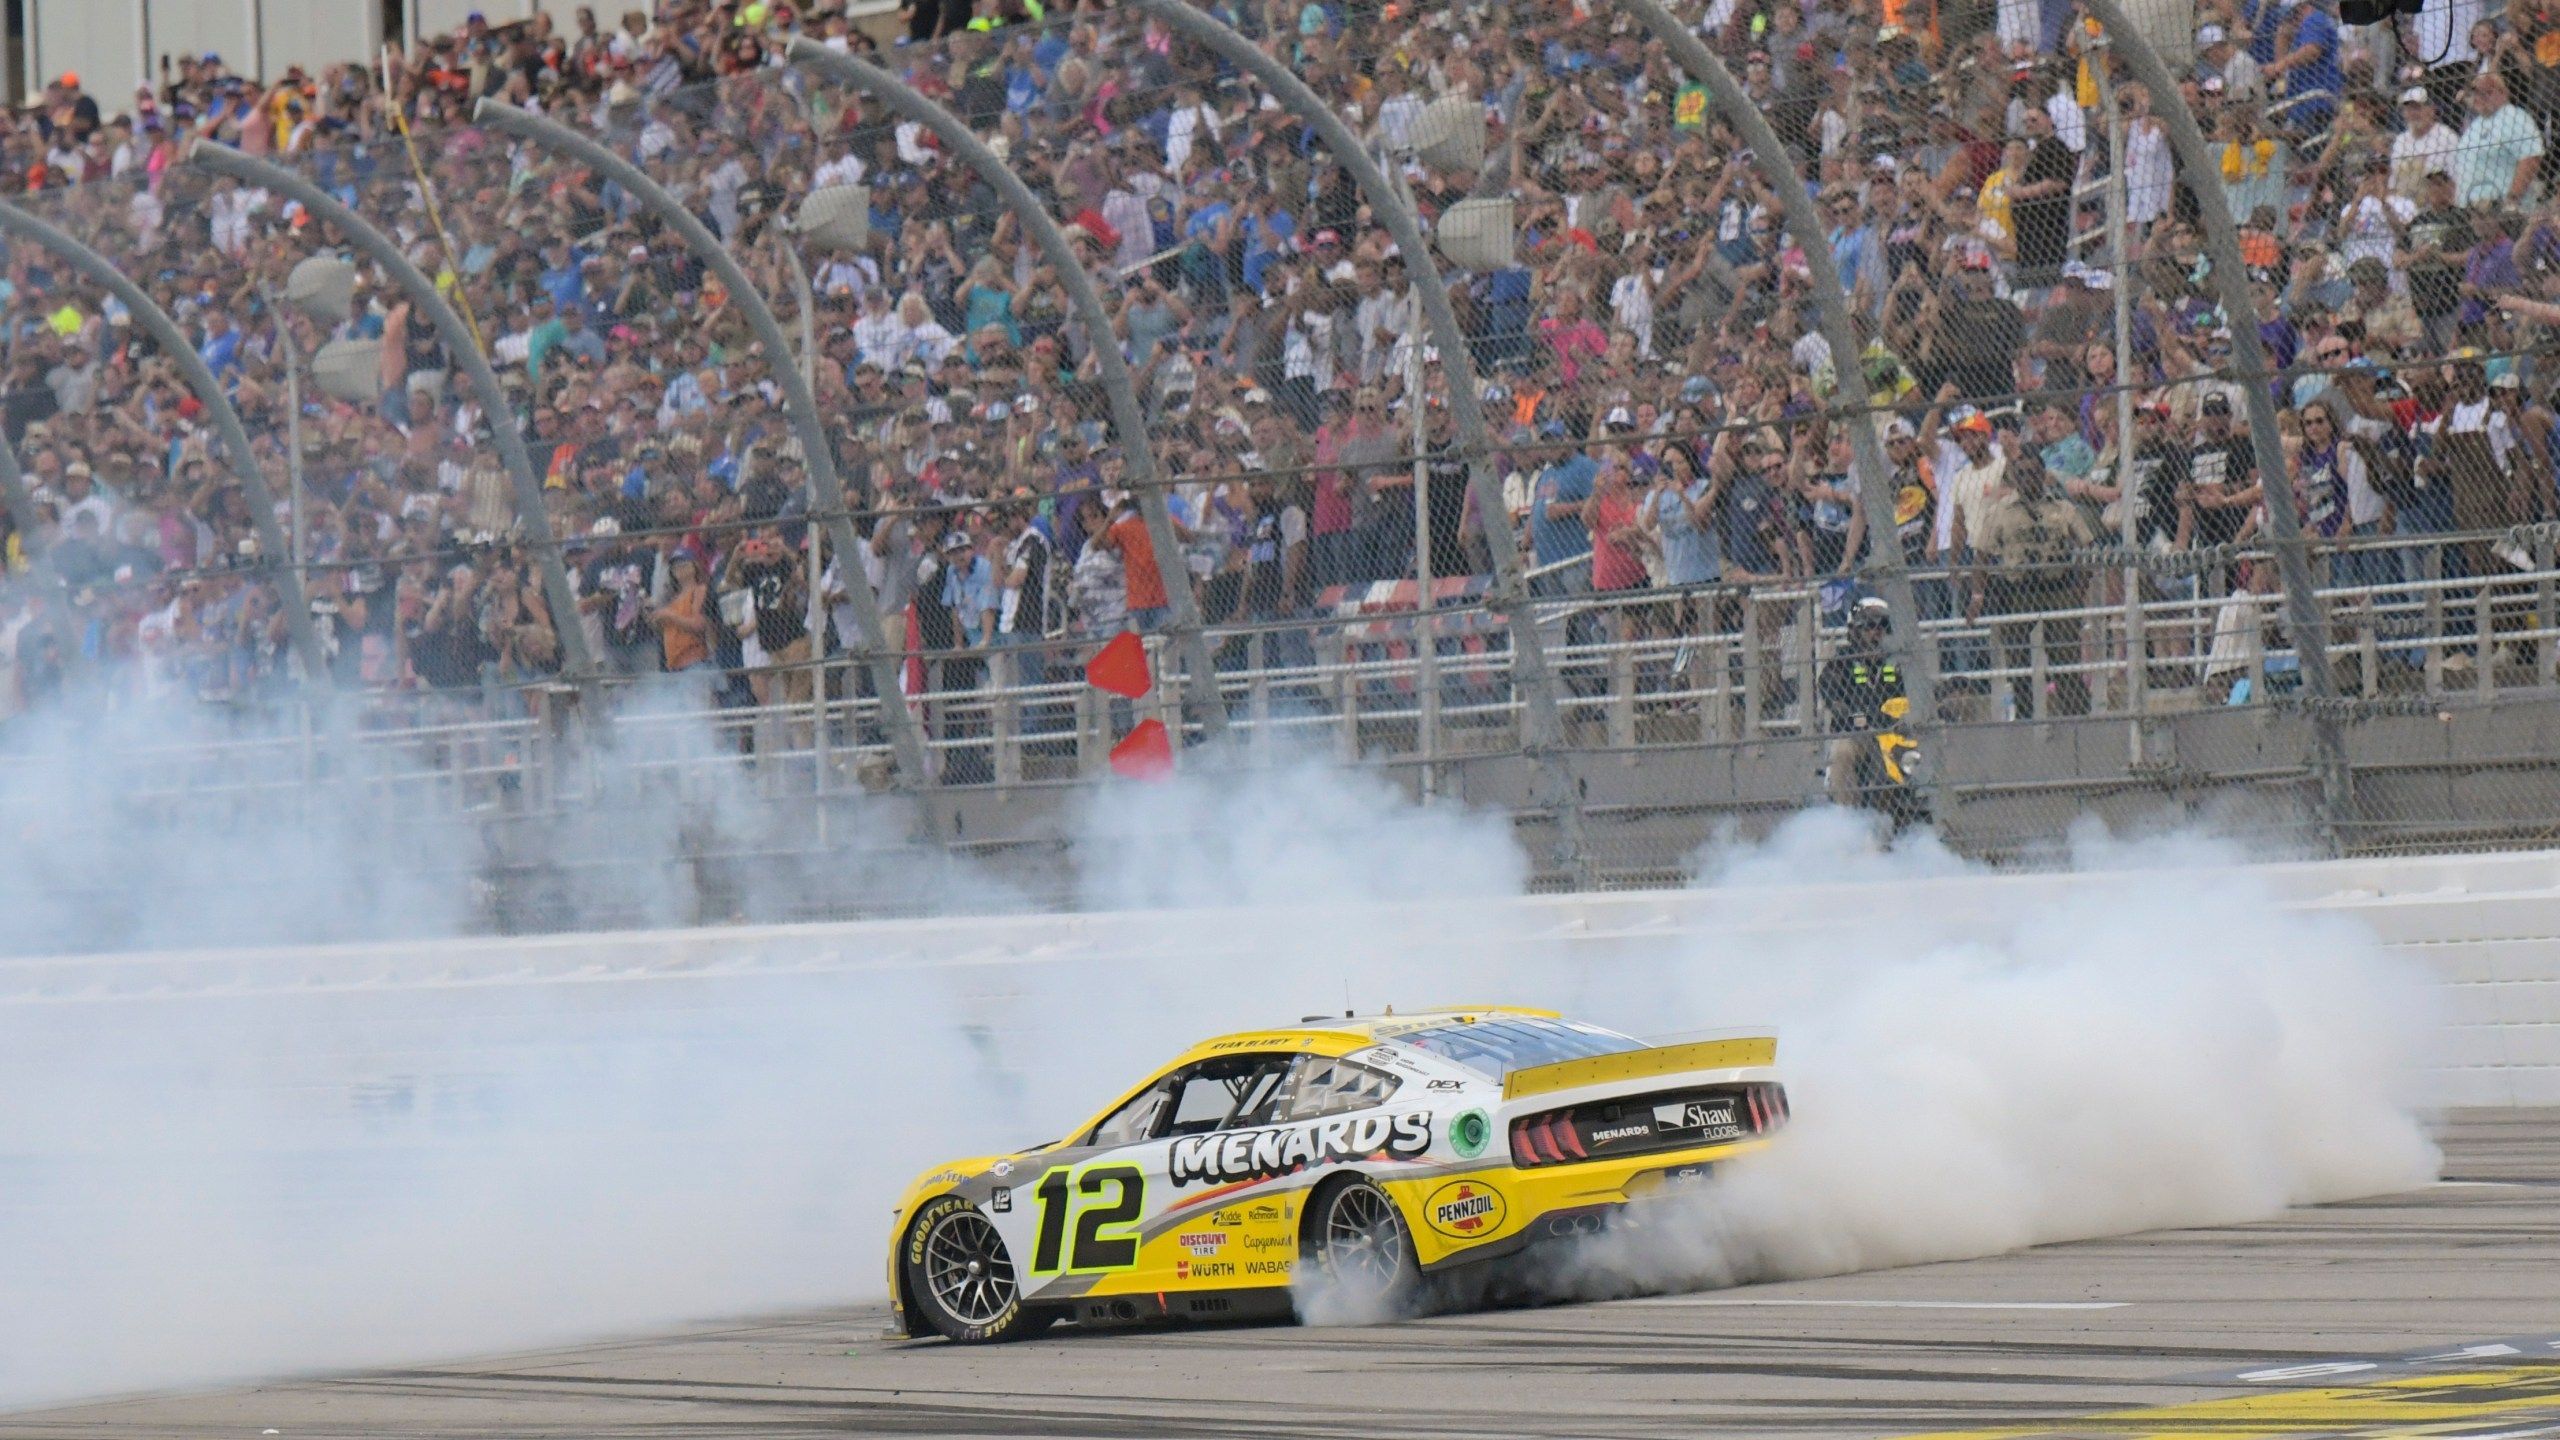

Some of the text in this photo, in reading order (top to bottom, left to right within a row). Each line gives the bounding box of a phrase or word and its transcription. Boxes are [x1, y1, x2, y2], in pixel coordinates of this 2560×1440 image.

[1426, 1080, 1467, 1089] DEX
[1687, 1105, 1732, 1126] Shaw
[1592, 1125, 1650, 1141] MENARDS
[1703, 1125, 1740, 1139] FLOORS
[1168, 1111, 1432, 1188] MENARDS
[1677, 1169, 1703, 1184] Ford
[994, 1190, 1010, 1204] 12
[1221, 1210, 1242, 1221] Kidde
[1438, 1195, 1493, 1223] PENNZOIL
[1034, 1166, 1144, 1272] 12
[911, 1199, 974, 1265] GOODYEAR
[1180, 1233, 1227, 1246] DISCOUNT
[1194, 1247, 1214, 1255] TIRE
[984, 1301, 1019, 1338] EAGLE
